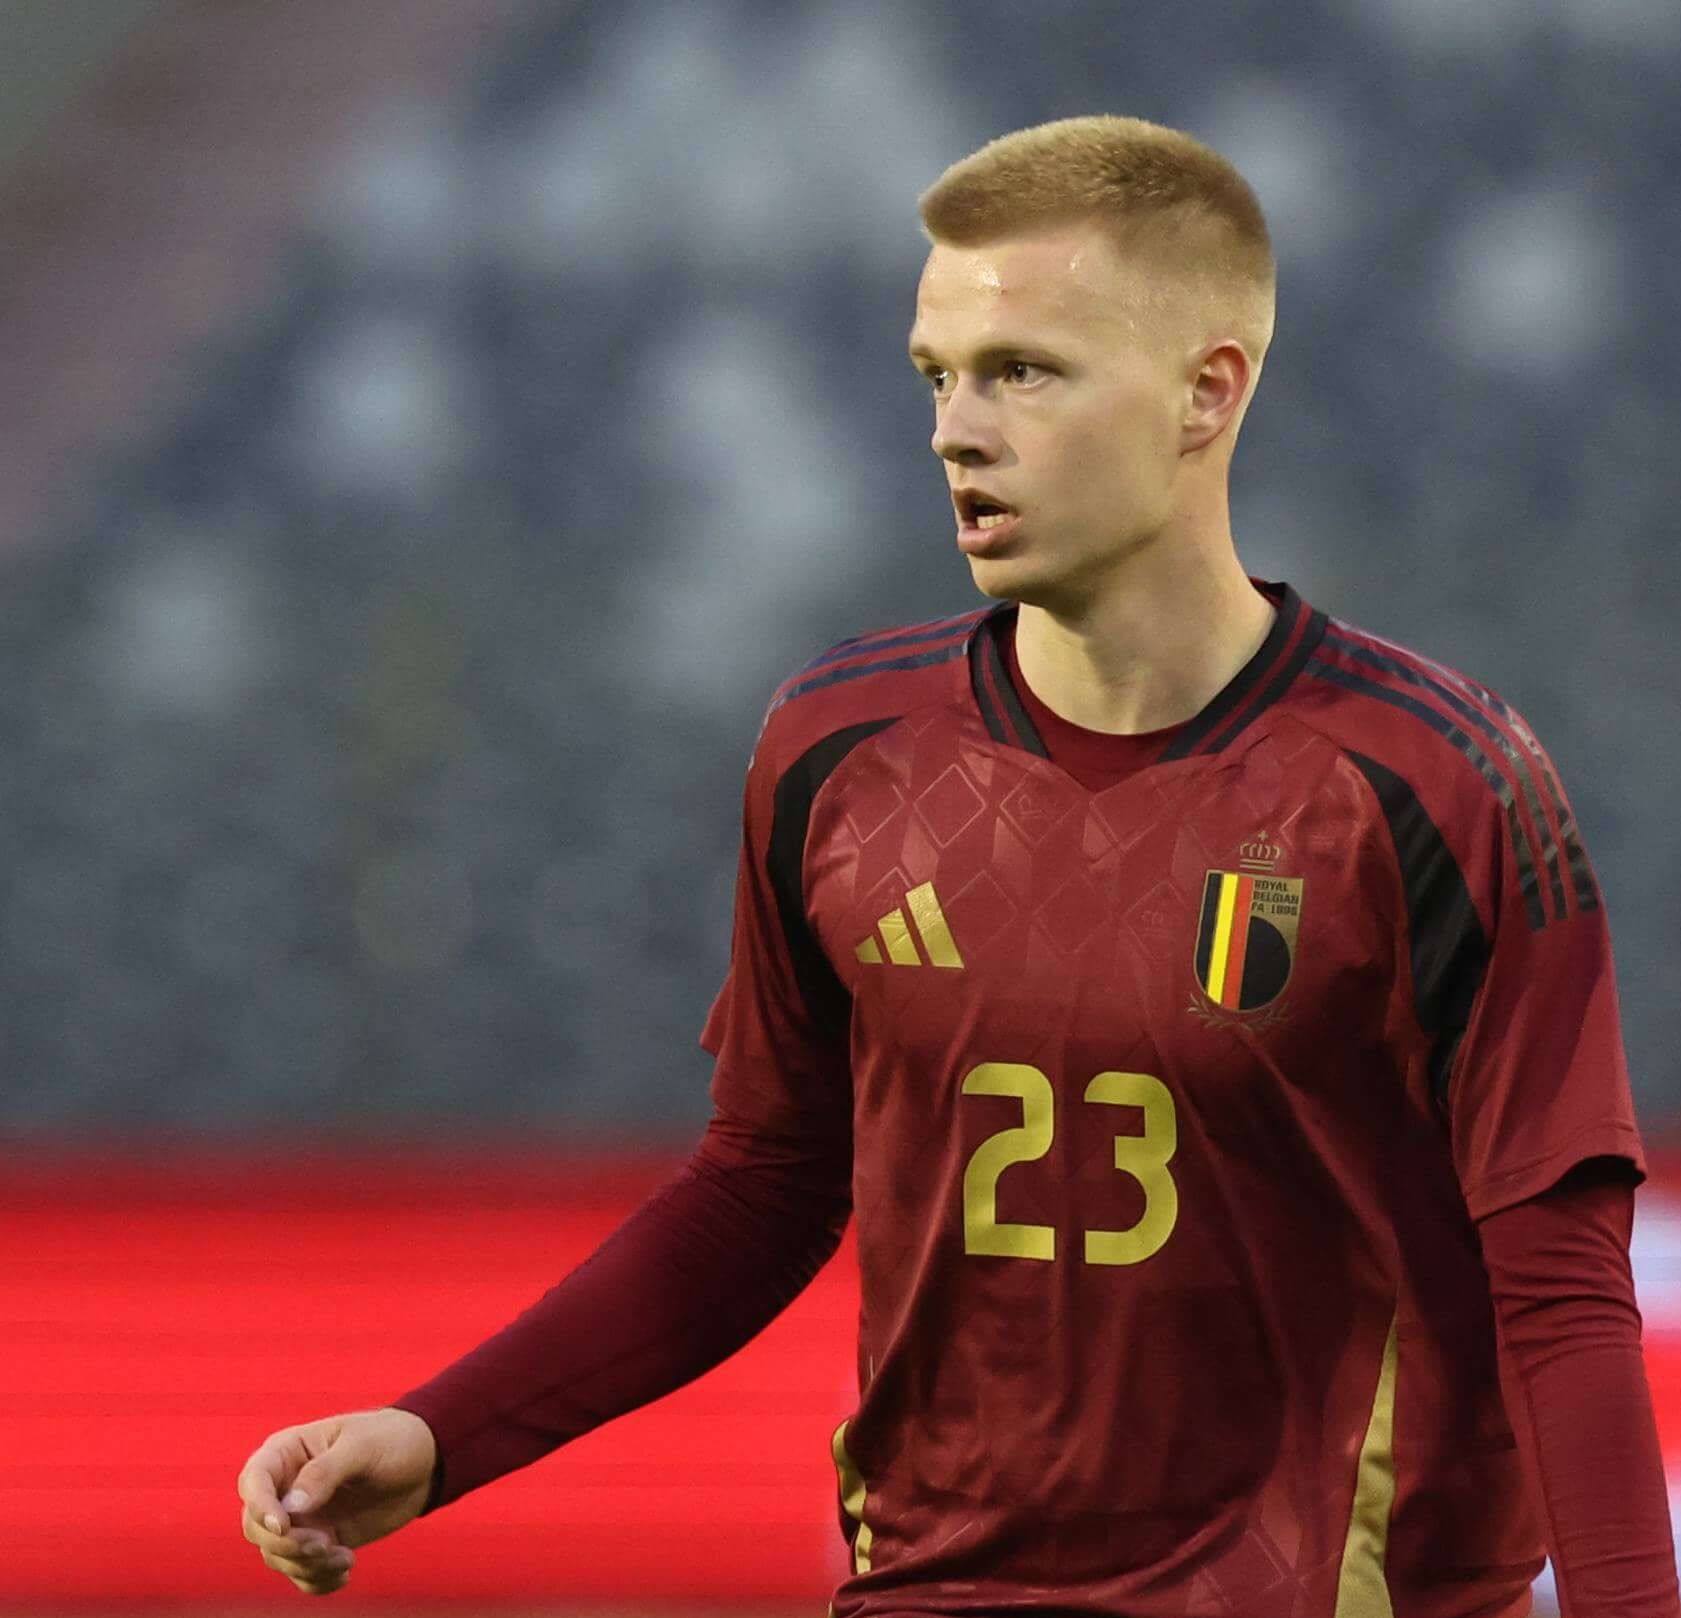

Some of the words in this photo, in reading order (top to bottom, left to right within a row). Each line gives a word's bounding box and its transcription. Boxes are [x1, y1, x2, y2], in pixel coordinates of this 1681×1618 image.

[1254, 879, 1287, 891] ROYAL
[1253, 890, 1299, 905] BELGIAN
[1251, 901, 1265, 913] FA
[961, 1062, 1179, 1266] 23
